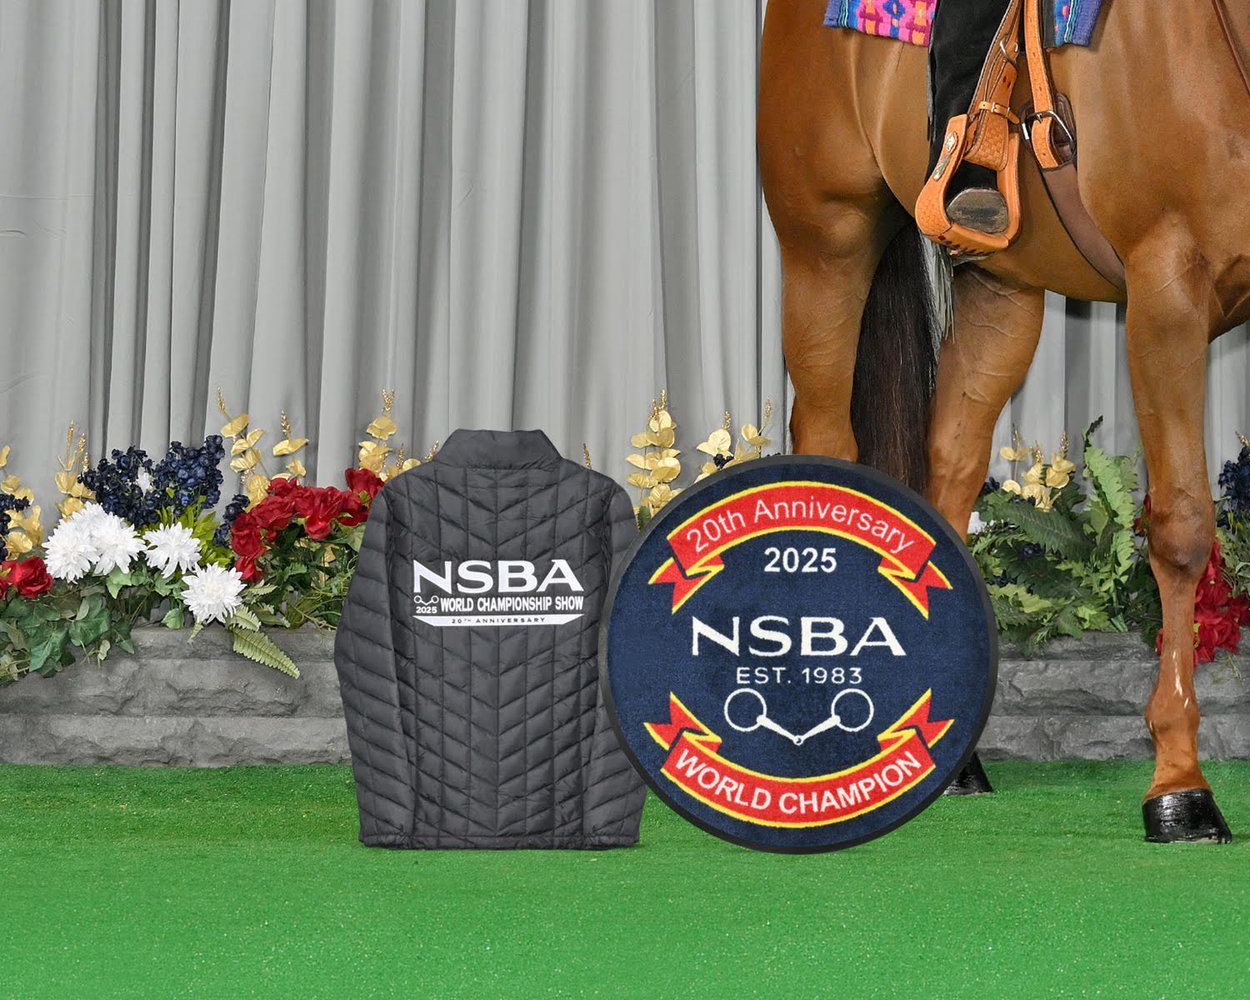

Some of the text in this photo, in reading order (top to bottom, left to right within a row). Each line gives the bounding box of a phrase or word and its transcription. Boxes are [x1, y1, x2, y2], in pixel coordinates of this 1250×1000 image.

[686, 496, 916, 555] 20th Anniversary
[763, 547, 838, 574] 2025
[412, 559, 585, 595] NSBA
[415, 605, 438, 614] 2025
[440, 595, 585, 613] WORLD CHAMPIONSHIP SHOW
[475, 616, 546, 624] ANNIVERSARY
[691, 615, 907, 658] NSBA
[736, 667, 864, 685] EST. 1983
[675, 748, 922, 815] WORLD CHAMPION
